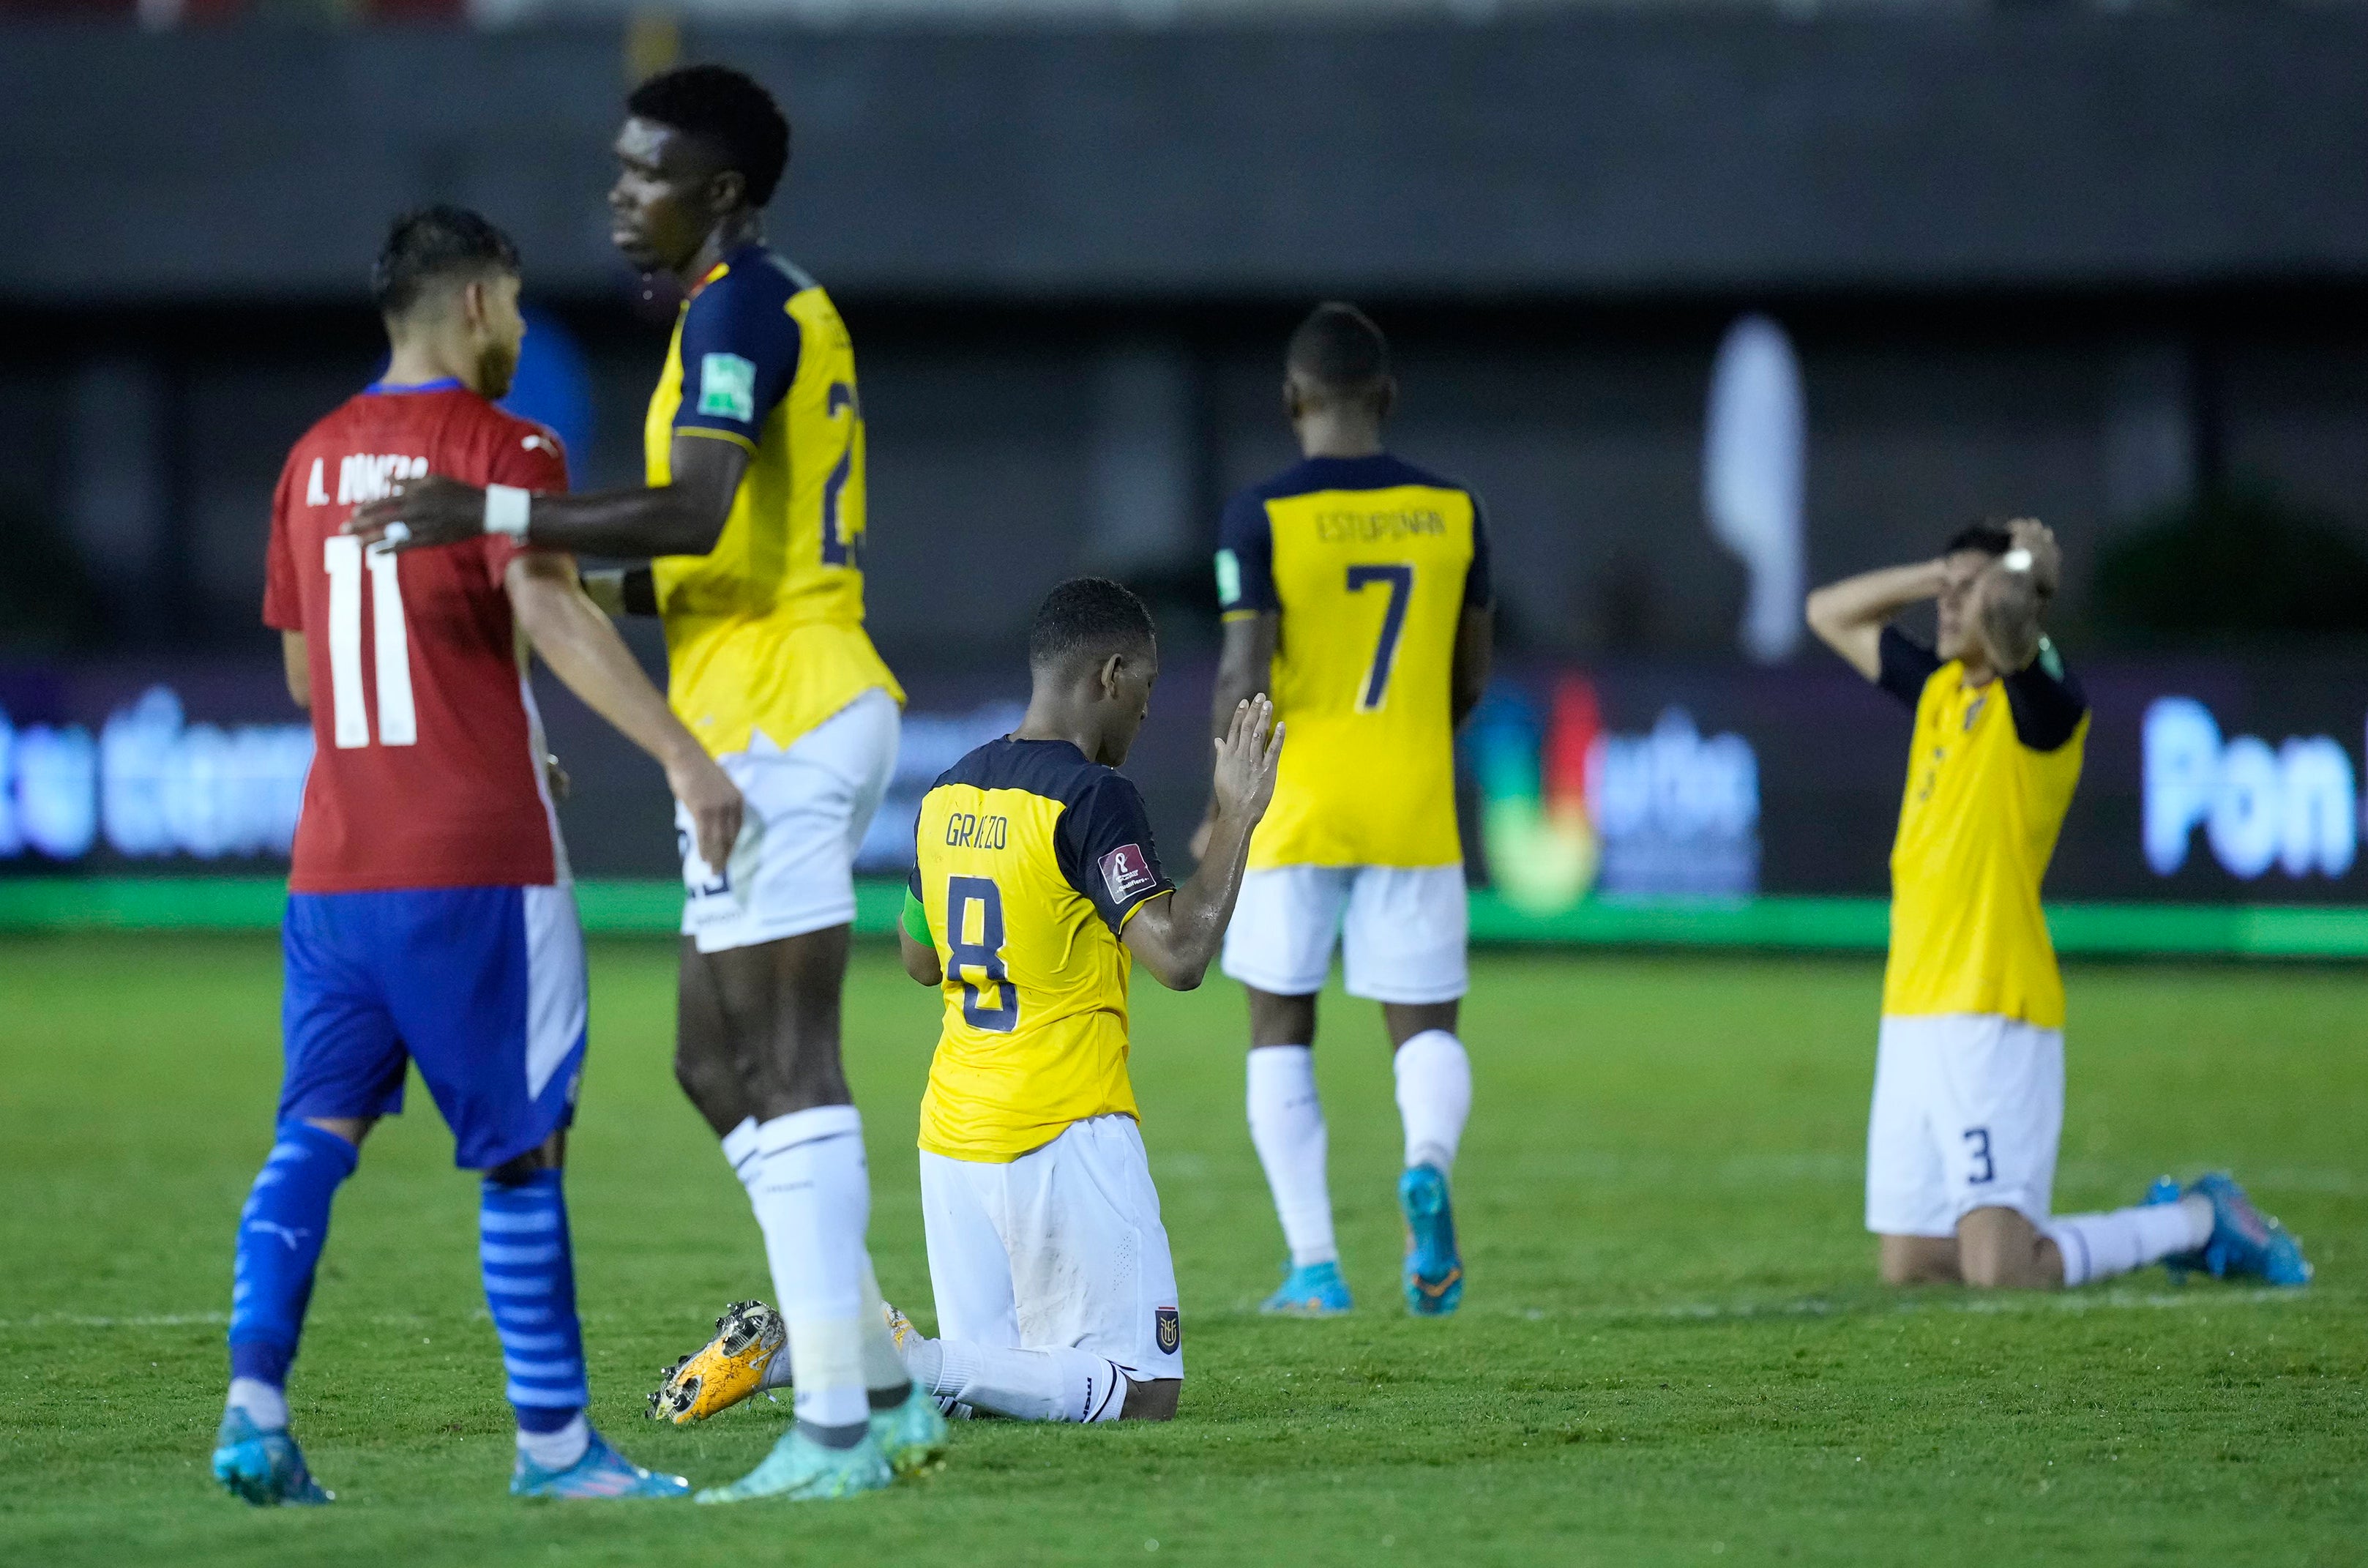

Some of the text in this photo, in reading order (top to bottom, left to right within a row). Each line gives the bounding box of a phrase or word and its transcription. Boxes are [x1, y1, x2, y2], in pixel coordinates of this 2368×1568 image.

[823, 378, 866, 567] 2
[324, 534, 417, 748] 11
[1345, 561, 1416, 714] 7
[946, 812, 1007, 850] GRZO
[2140, 694, 2357, 880] Pon
[946, 875, 1019, 1034] 8
[1118, 878, 1145, 891] Qualifiers
[1962, 1126, 1995, 1184] 3
